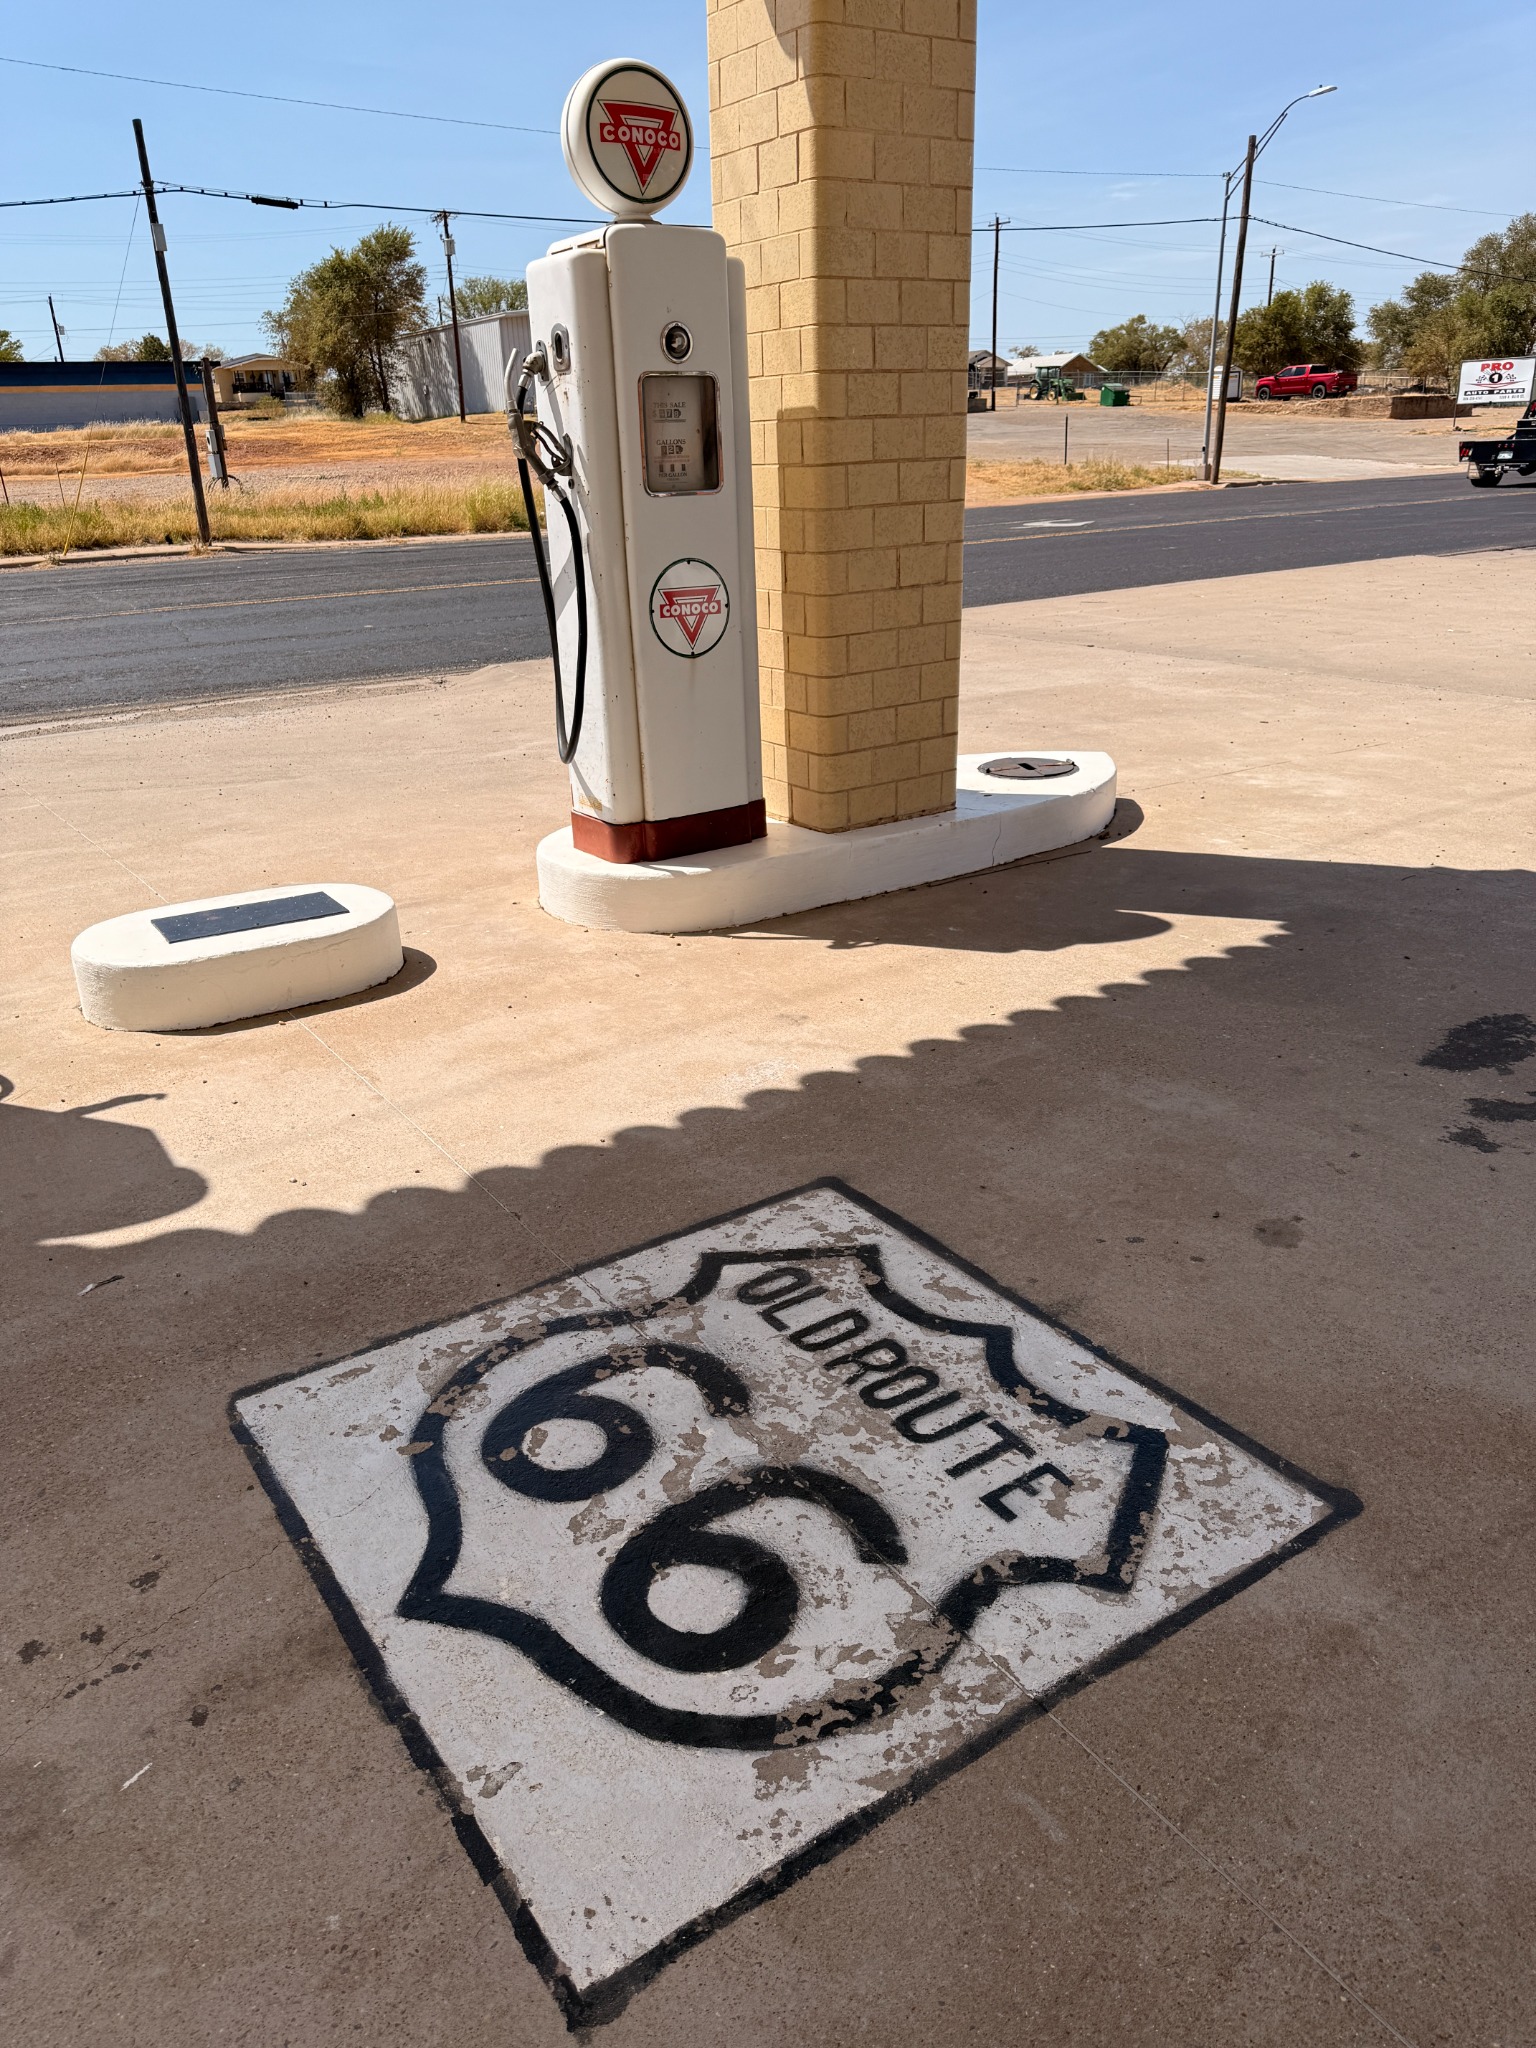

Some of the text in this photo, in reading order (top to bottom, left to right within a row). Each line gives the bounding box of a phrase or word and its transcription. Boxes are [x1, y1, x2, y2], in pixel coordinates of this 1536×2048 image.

[602, 124, 679, 147] CONOCO
[1480, 361, 1514, 372] PRO
[656, 438, 687, 446] GALLONS
[662, 601, 719, 617] CONOCO
[481, 1343, 909, 1674] 66
